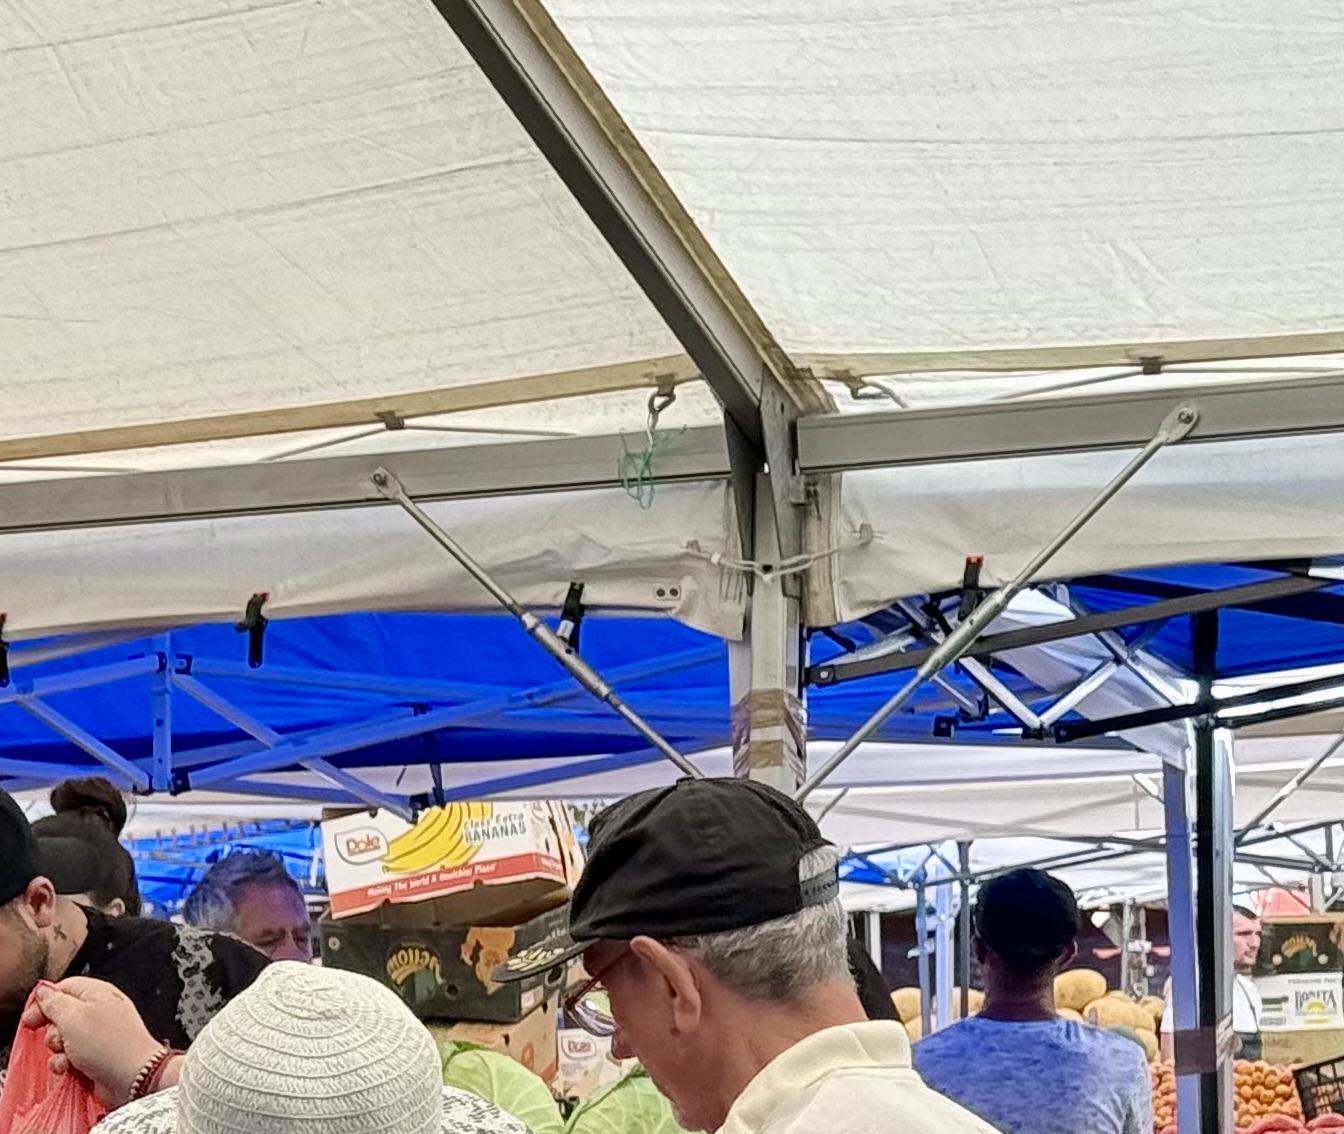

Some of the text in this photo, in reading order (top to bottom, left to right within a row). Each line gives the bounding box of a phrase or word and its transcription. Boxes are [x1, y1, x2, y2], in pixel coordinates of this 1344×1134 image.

[346, 834, 380, 852] Dole
[464, 821, 527, 844] BANANAS
[1295, 990, 1338, 1014] BONITA
